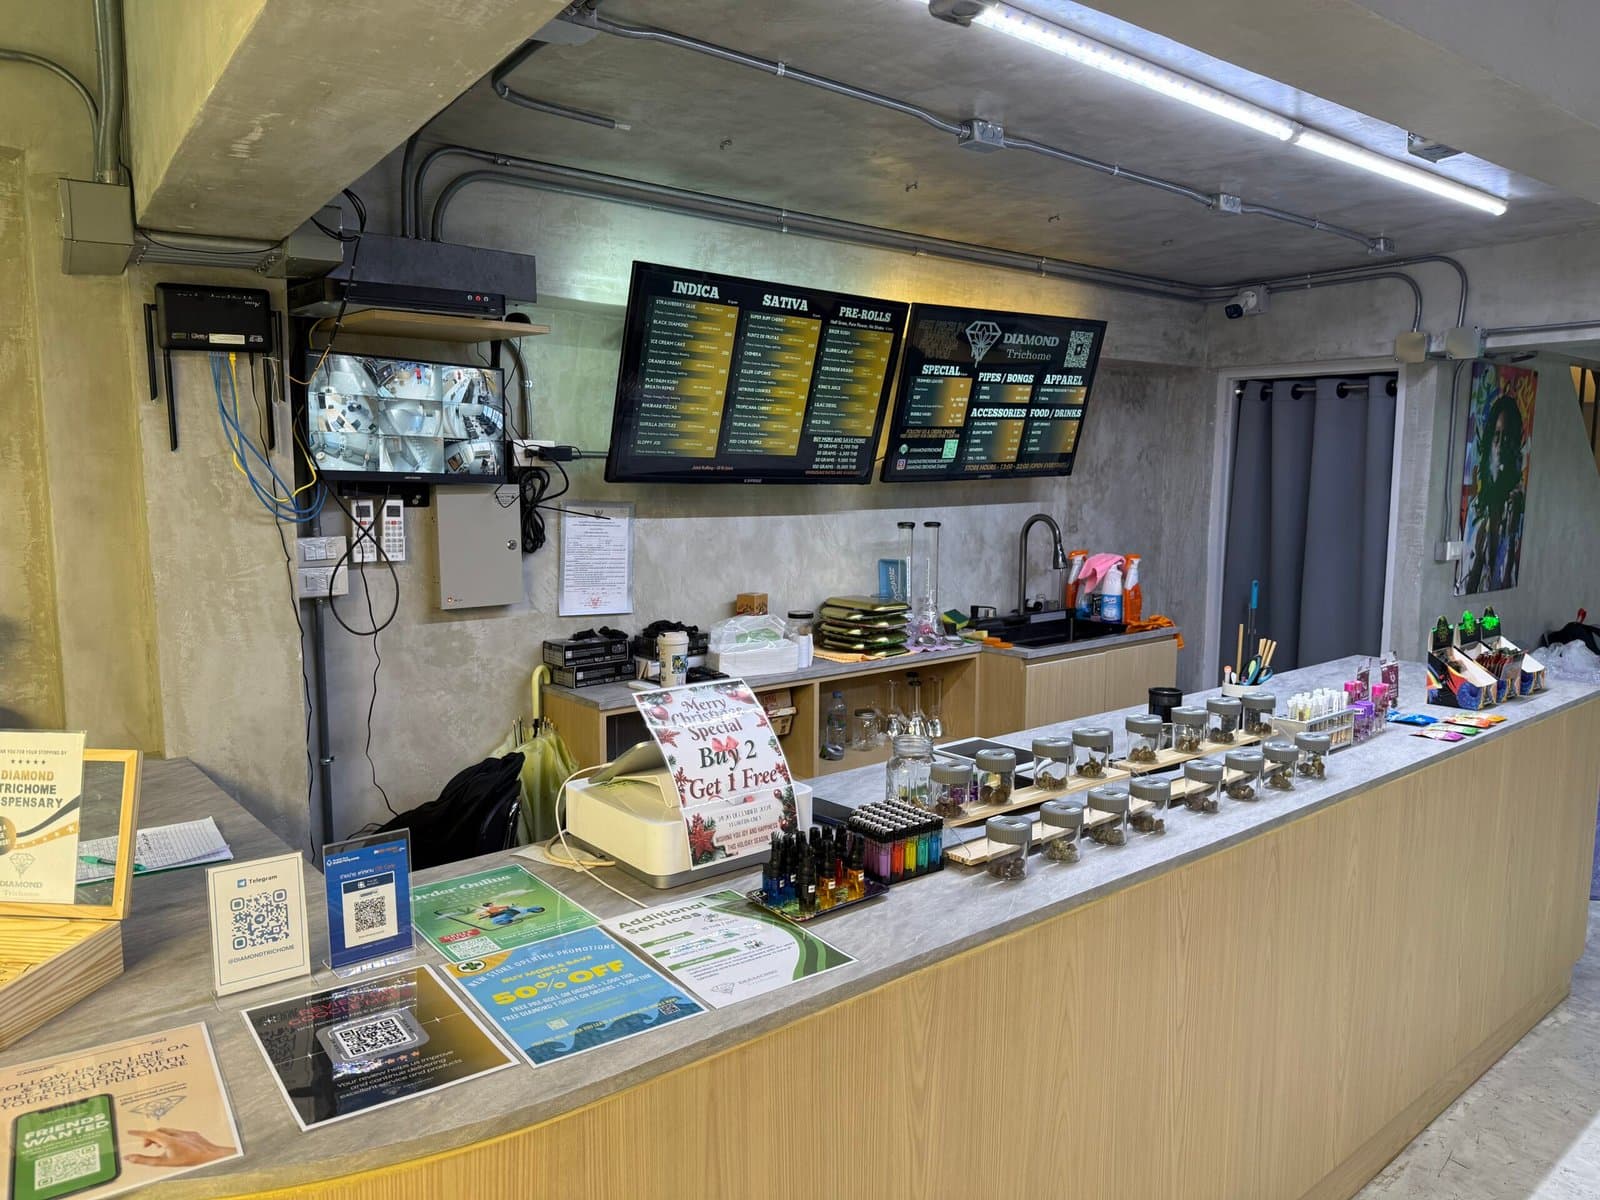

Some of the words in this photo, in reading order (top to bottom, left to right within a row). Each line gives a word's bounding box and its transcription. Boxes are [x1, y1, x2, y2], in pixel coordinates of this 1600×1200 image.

[672, 281, 720, 299] INDICA
[762, 294, 808, 311] SATIVA
[839, 306, 891, 322] PRE-ROLLS
[1002, 332, 1060, 348] DIAMOND
[1006, 348, 1052, 361] Trichome
[922, 364, 961, 377] SPECIAL
[977, 372, 1002, 383] PIPES
[1006, 374, 1034, 383] BONGS
[1044, 374, 1083, 386] APPAREL
[970, 408, 1027, 418] ACCESSORIES
[1029, 409, 1050, 418] FOOD
[1054, 409, 1082, 418] DRINKS
[681, 694, 728, 713] Merry
[688, 718, 743, 741] Special
[699, 745, 741, 769] Buy
[744, 740, 757, 760] 2
[1, 769, 54, 781] DIAMOND
[689, 778, 721, 800] Get
[727, 772, 736, 791] 1
[742, 767, 777, 789] Free
[0, 783, 57, 795] TRICHOME
[0, 796, 63, 808] SPENSARY
[758, 822, 778, 833] HAPPINESS
[737, 840, 753, 848] HOLIDAY
[249, 874, 277, 886] Telegram
[410, 885, 458, 903] Order
[460, 874, 512, 891] Online
[618, 901, 707, 930] Additional
[626, 911, 702, 936] Services
[228, 943, 295, 965] @DIAMONDTRICHOME
[467, 974, 484, 988] NEW
[485, 964, 514, 981] STORE
[514, 952, 554, 968] OPENING
[556, 943, 616, 956] PROMOTIONS
[491, 978, 567, 1006] 50%
[568, 959, 625, 984] OFF
[288, 1002, 360, 1027] GOOGLE
[299, 995, 365, 1017] REVIEW
[500, 1013, 520, 1022] FREE
[518, 1003, 554, 1017] DIAMOND
[509, 1003, 529, 1012] FREE
[73, 1065, 94, 1074] US
[97, 1058, 122, 1069] ON
[126, 1048, 162, 1062] LINE
[166, 1042, 189, 1052] OA
[88, 1066, 138, 1084] JOINT
[143, 1054, 186, 1069] WITH
[336, 1078, 357, 1088] Your
[357, 1070, 386, 1082] review
[386, 1063, 410, 1073] helps
[419, 1050, 455, 1063] improve
[36, 1068, 108, 1089] RECEIVE
[125, 1054, 163, 1068] FREE
[338, 1084, 378, 1099] excellent
[377, 1075, 408, 1087] service
[408, 1069, 427, 1078] and
[425, 1058, 464, 1073] products
[349, 1081, 369, 1090] and
[367, 1070, 407, 1084] continue
[406, 1057, 448, 1073] delivering
[3, 1093, 49, 1109] YOUR
[53, 1082, 98, 1097] NEXT
[102, 1059, 189, 1085] PURCHASE
[23, 1120, 110, 1148] WANTED
[25, 1112, 107, 1139] FRIENDS
